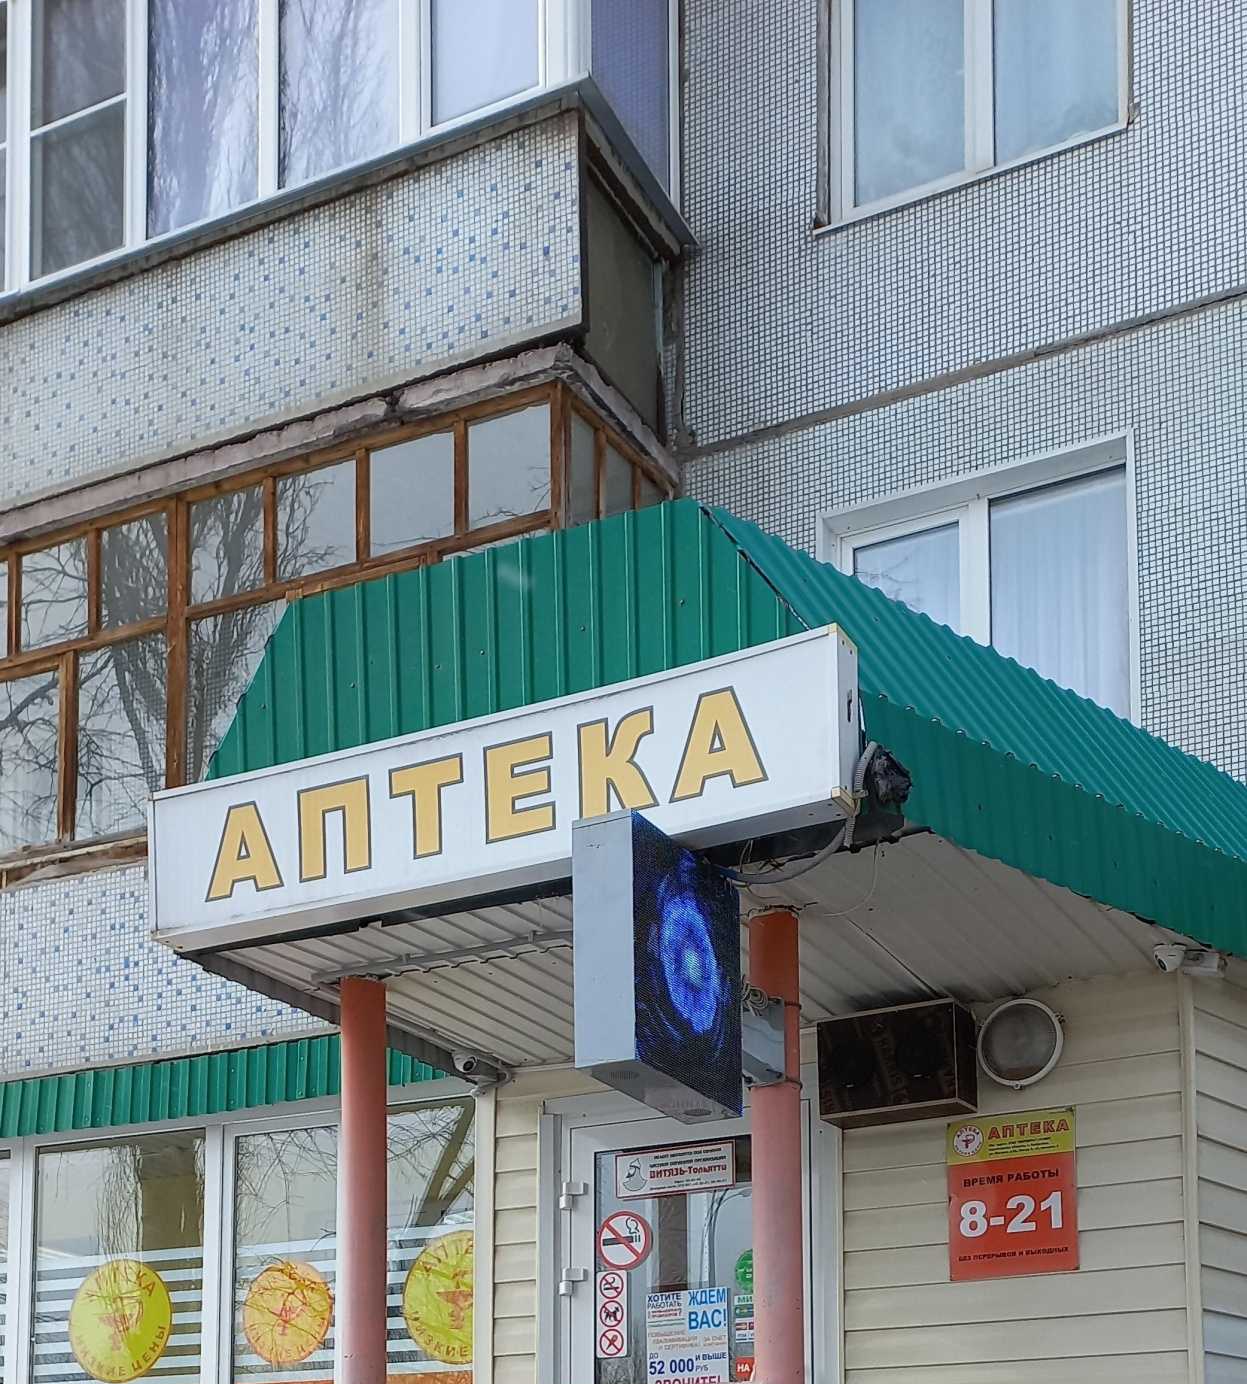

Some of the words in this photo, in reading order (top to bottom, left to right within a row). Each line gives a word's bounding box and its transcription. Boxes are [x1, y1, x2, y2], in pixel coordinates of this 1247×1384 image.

[204, 685, 768, 902] АПТЕКА
[988, 1119, 1070, 1140] АПТЕКА
[963, 1174, 1003, 1188] ВРЕМЯ
[1007, 1168, 1059, 1183] РАБОТЫ
[959, 1190, 1064, 1238] 8-21
[647, 1292, 681, 1303] ХОТИТЕ
[688, 1288, 726, 1306] ЖДЕМ
[688, 1308, 727, 1330] ВАС!
[131, 1325, 166, 1372] ЦЕНЫ
[649, 1360, 665, 1375] 52
[669, 1358, 695, 1374] 000
